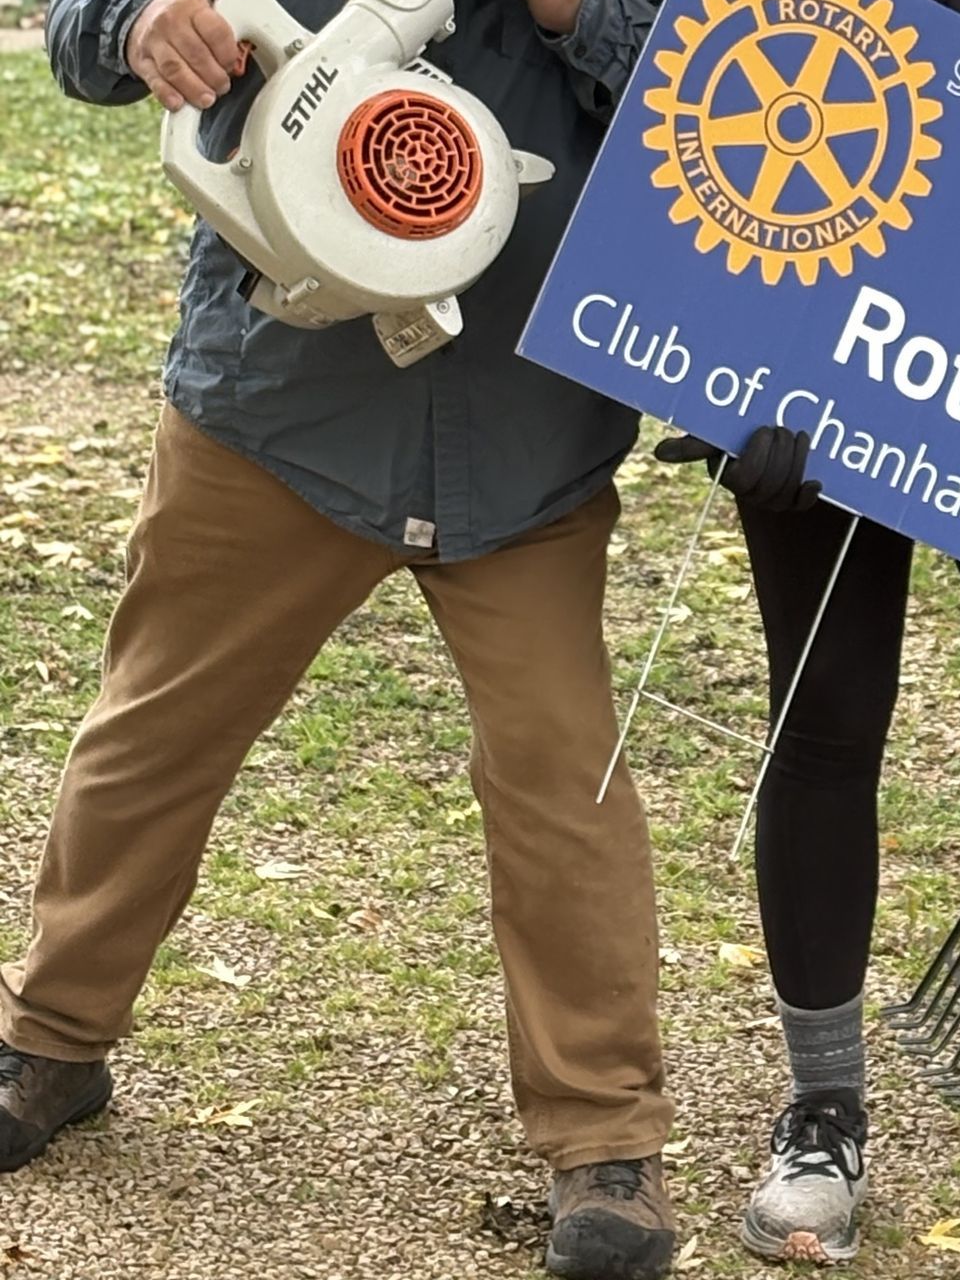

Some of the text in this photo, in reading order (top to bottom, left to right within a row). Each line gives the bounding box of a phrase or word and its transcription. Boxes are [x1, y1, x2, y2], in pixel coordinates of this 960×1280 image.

[281, 65, 339, 141] STIHL
[677, 130, 870, 250] INTERNATIONAL
[572, 294, 691, 384] Club
[705, 366, 771, 417] of
